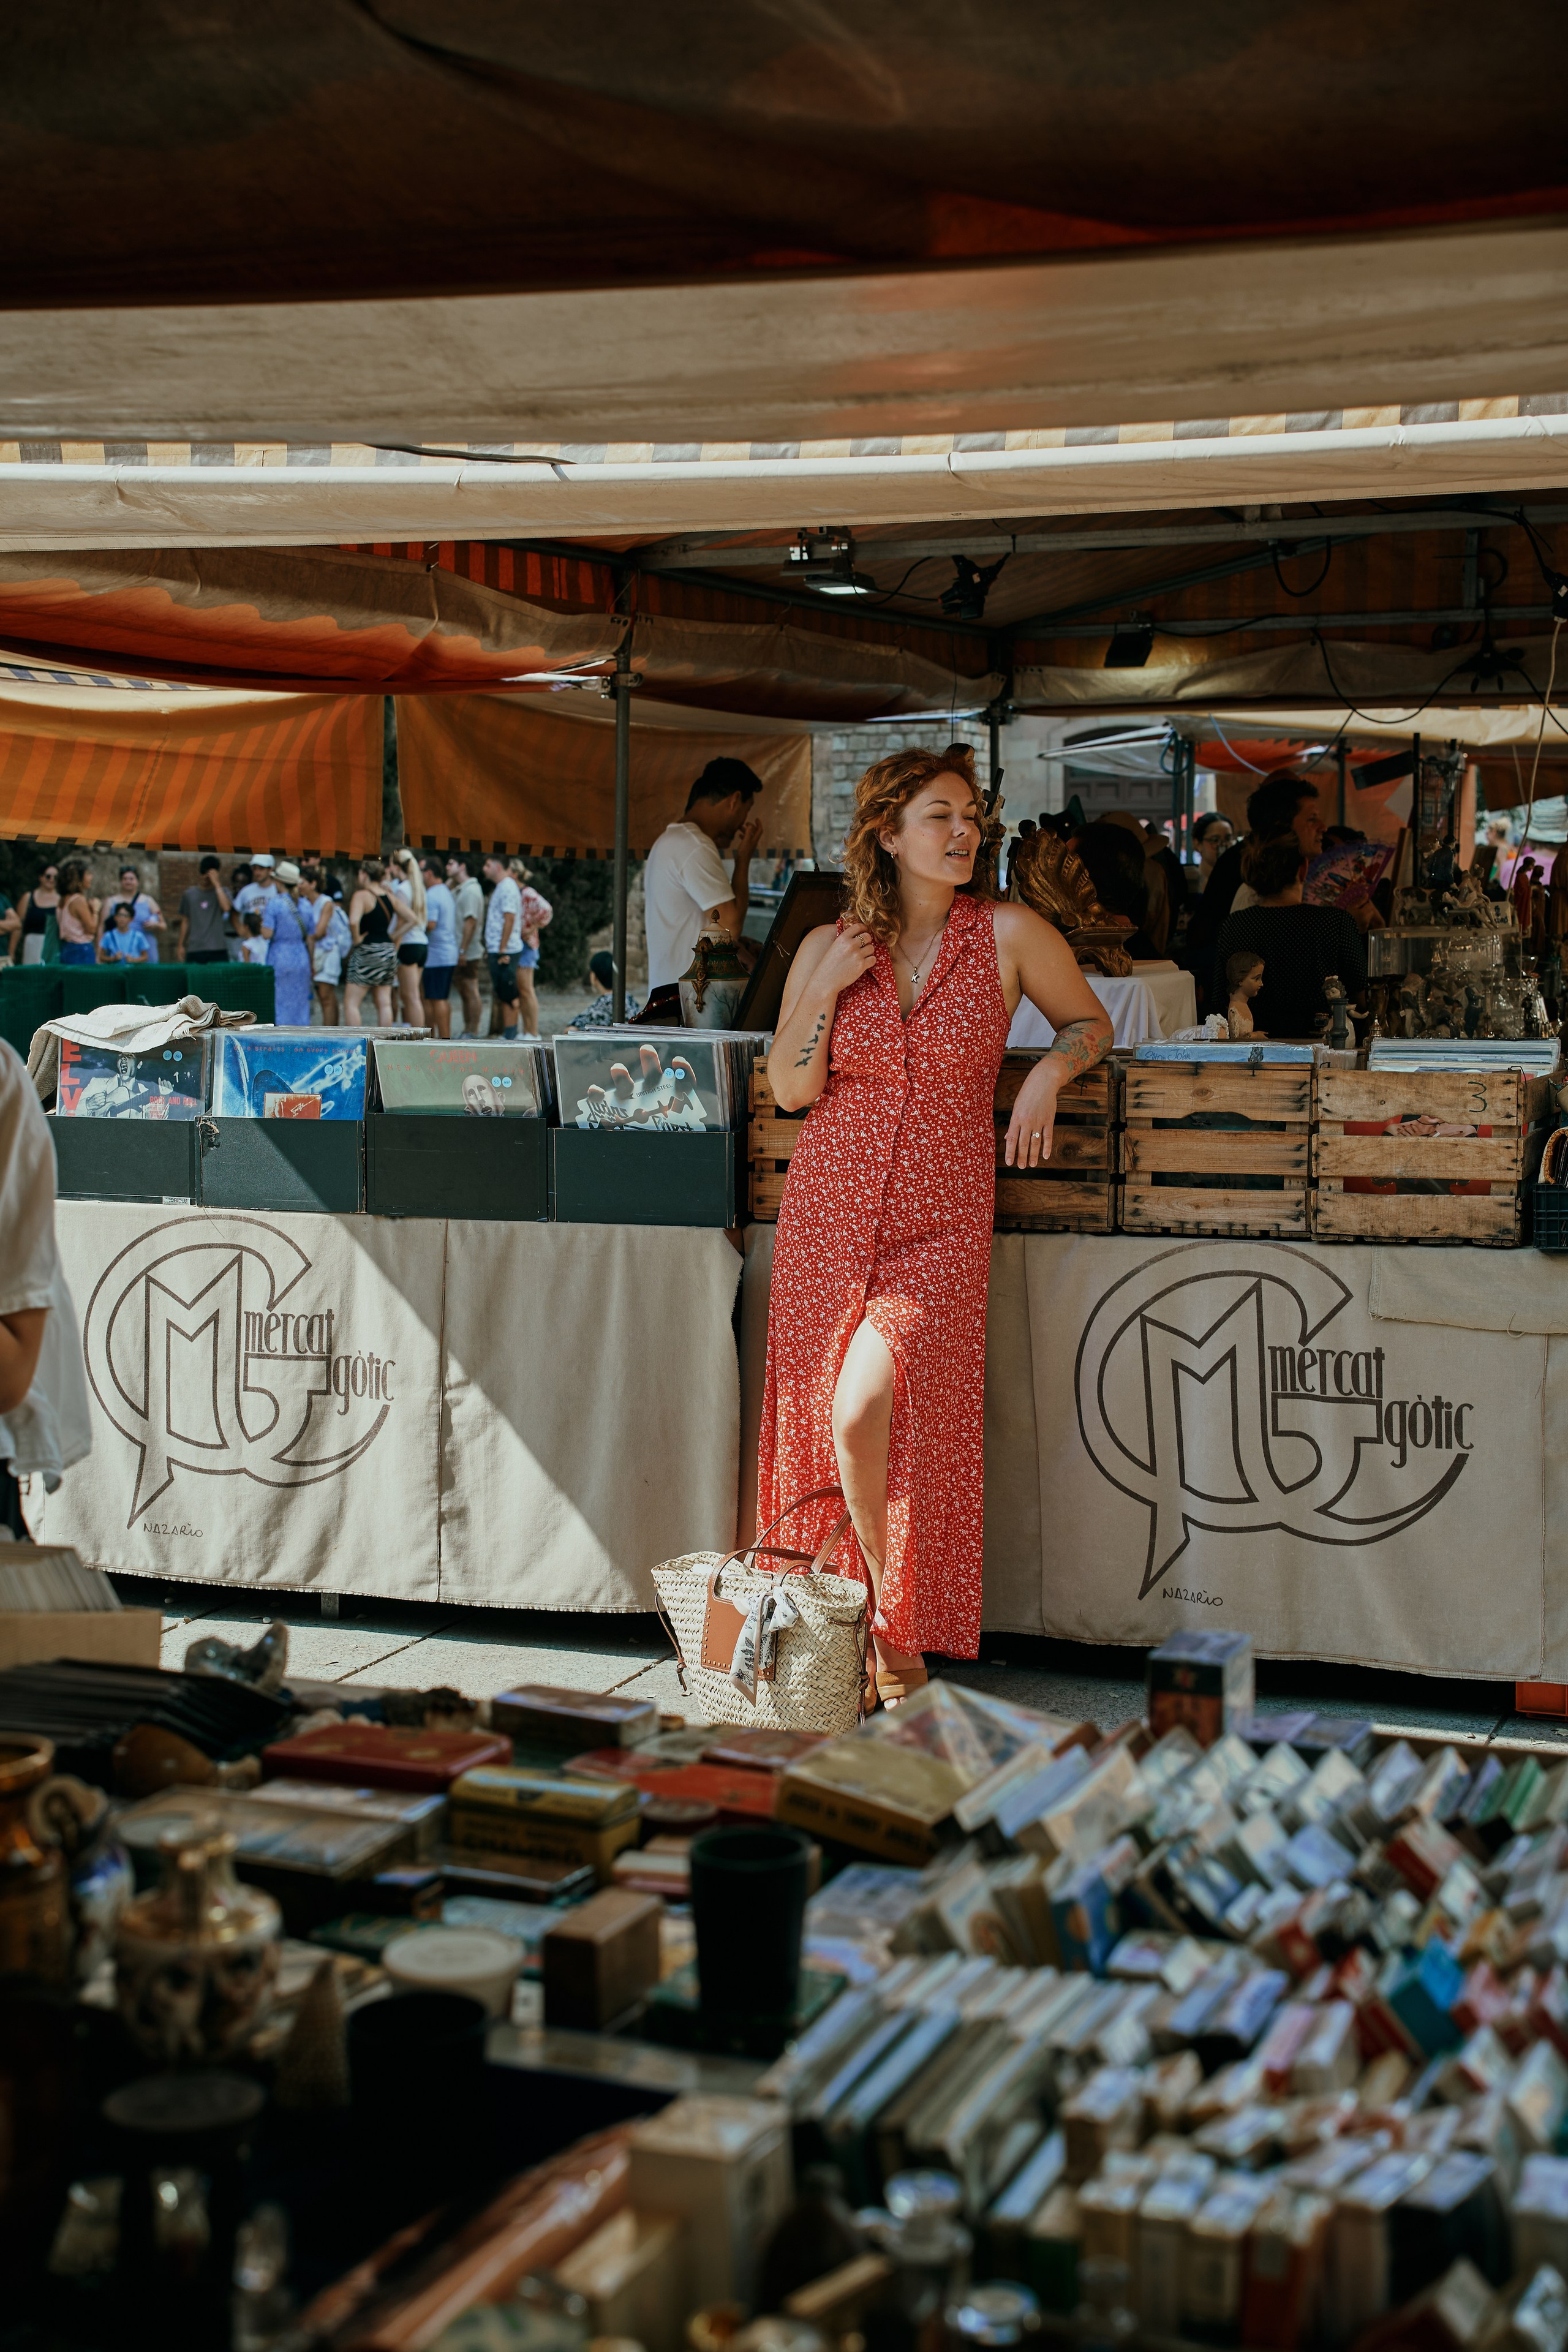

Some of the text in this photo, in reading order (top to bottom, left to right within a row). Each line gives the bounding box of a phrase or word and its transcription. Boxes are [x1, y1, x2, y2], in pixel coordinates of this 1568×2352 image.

[430, 1049, 477, 1063] QUEEN
[1167, 1049, 1191, 1061] John
[61, 1037, 83, 1116] ELV
[636, 1088, 657, 1097] BRITISH
[1468, 1080, 1488, 1113] 3
[149, 1096, 198, 1106] ROCK AND ROLL
[244, 1308, 334, 1355] mercat
[333, 1350, 396, 1415] gòtic
[1267, 1346, 1385, 1399] mercat
[1384, 1394, 1474, 1469] gòtic
